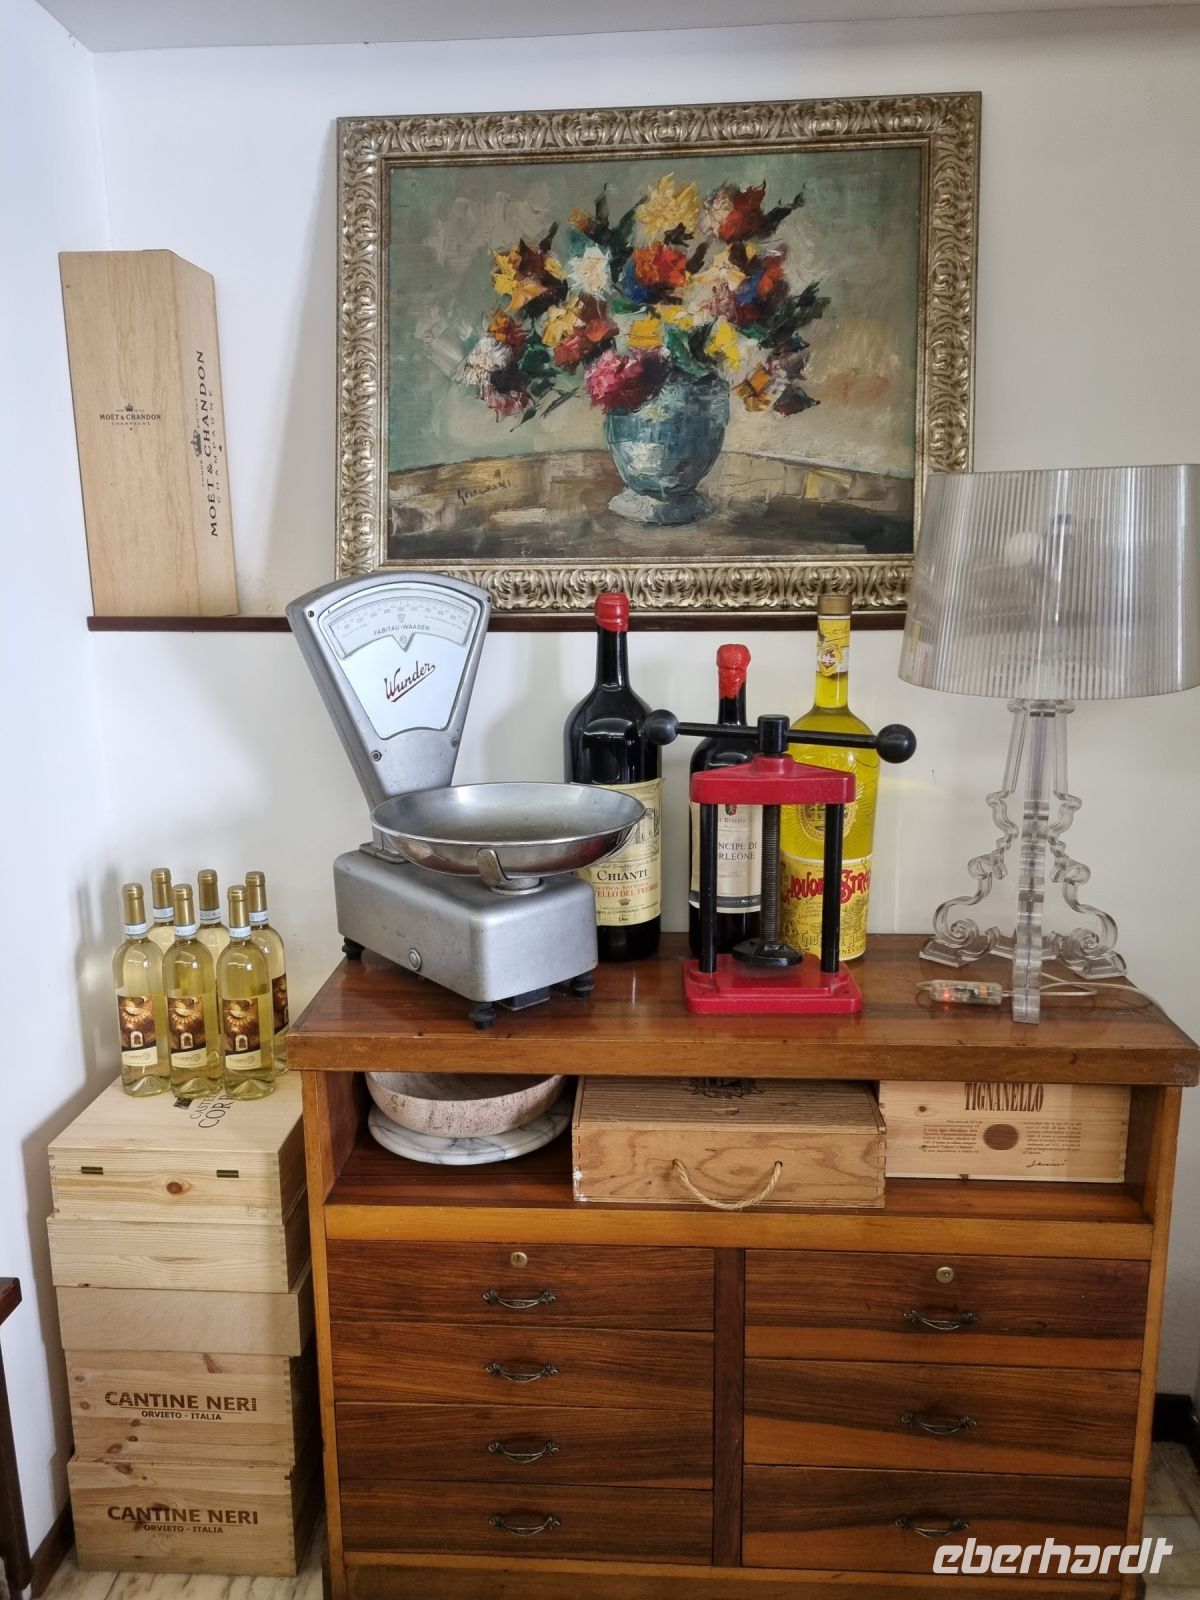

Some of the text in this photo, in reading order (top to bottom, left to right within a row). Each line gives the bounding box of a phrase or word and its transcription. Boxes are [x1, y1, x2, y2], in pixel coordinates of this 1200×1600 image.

[196, 350, 212, 458] CHANDON
[125, 413, 161, 421] CHANDON
[208, 390, 221, 504] CHAMPAGNE
[206, 463, 214, 475] &
[383, 660, 436, 702] Wunder
[718, 841, 758, 850] NCIPE DI
[718, 852, 756, 861] RLEONE
[596, 869, 648, 881] CHIANTI
[964, 1082, 1044, 1112] TIGNANELLO
[104, 1391, 257, 1412] CANTINE NERI
[141, 1410, 182, 1419] ORVIETO
[190, 1412, 223, 1421] ITALIA
[107, 1506, 259, 1525] CANTINE NERI
[143, 1524, 184, 1533] ORVIETO
[192, 1526, 224, 1534] ITALIA
